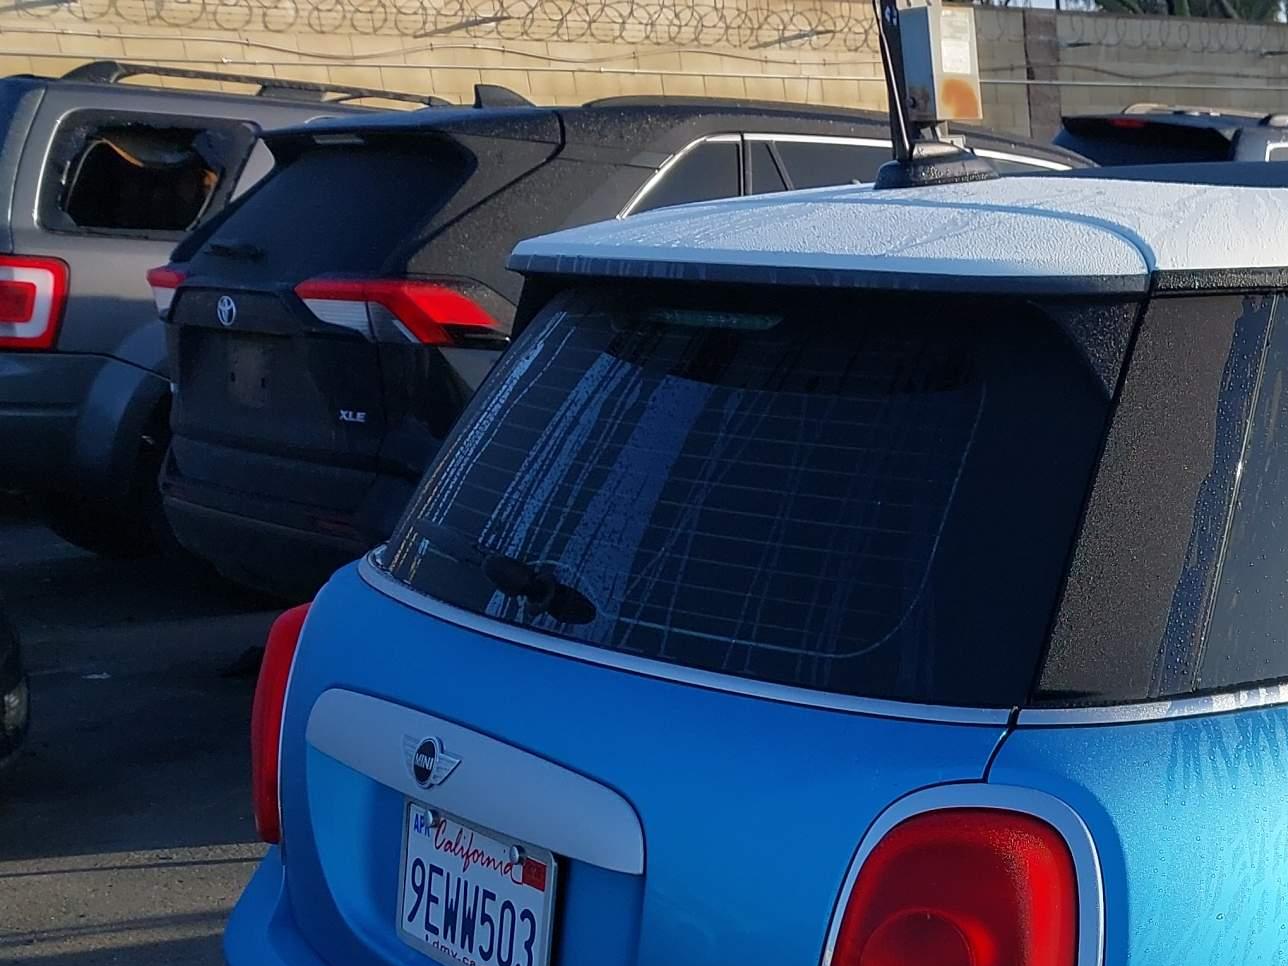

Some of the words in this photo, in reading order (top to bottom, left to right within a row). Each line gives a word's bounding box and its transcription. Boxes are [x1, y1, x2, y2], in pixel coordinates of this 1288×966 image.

[339, 409, 367, 422] XLE
[415, 751, 435, 771] MINI
[434, 819, 518, 880] California
